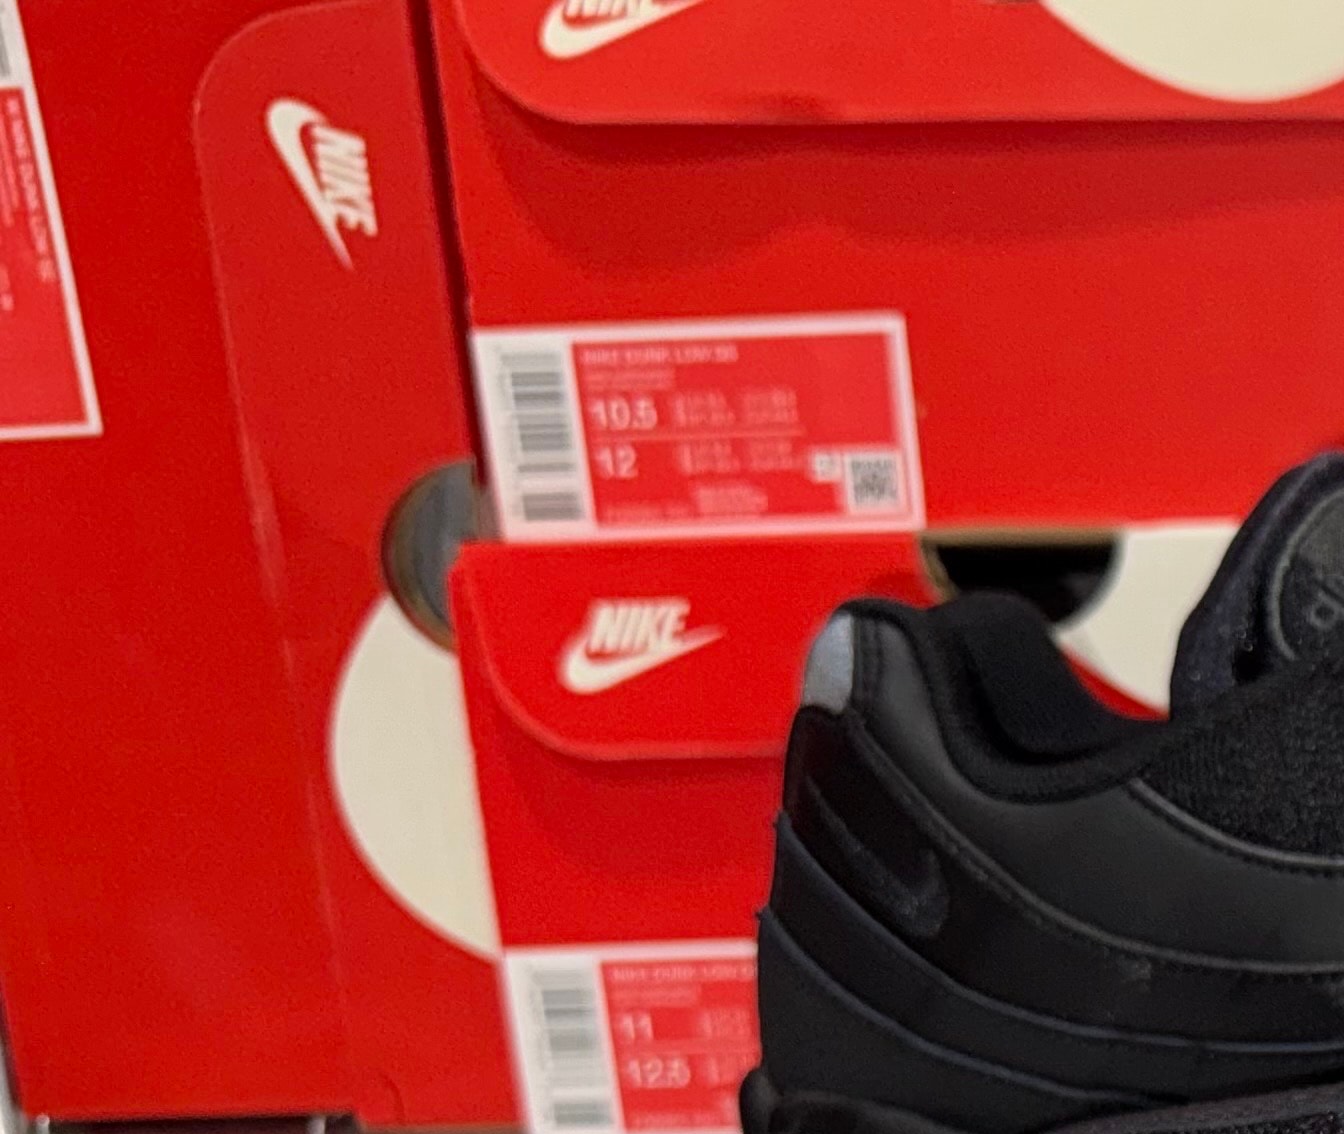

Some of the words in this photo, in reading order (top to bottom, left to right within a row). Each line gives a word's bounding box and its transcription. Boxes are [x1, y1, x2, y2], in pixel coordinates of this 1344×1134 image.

[311, 122, 379, 239] NIKE
[589, 395, 657, 430] 10.5
[594, 443, 638, 478] 12
[587, 598, 691, 652] NIKE
[616, 1012, 654, 1043] 11
[625, 1056, 691, 1089] 12.5
